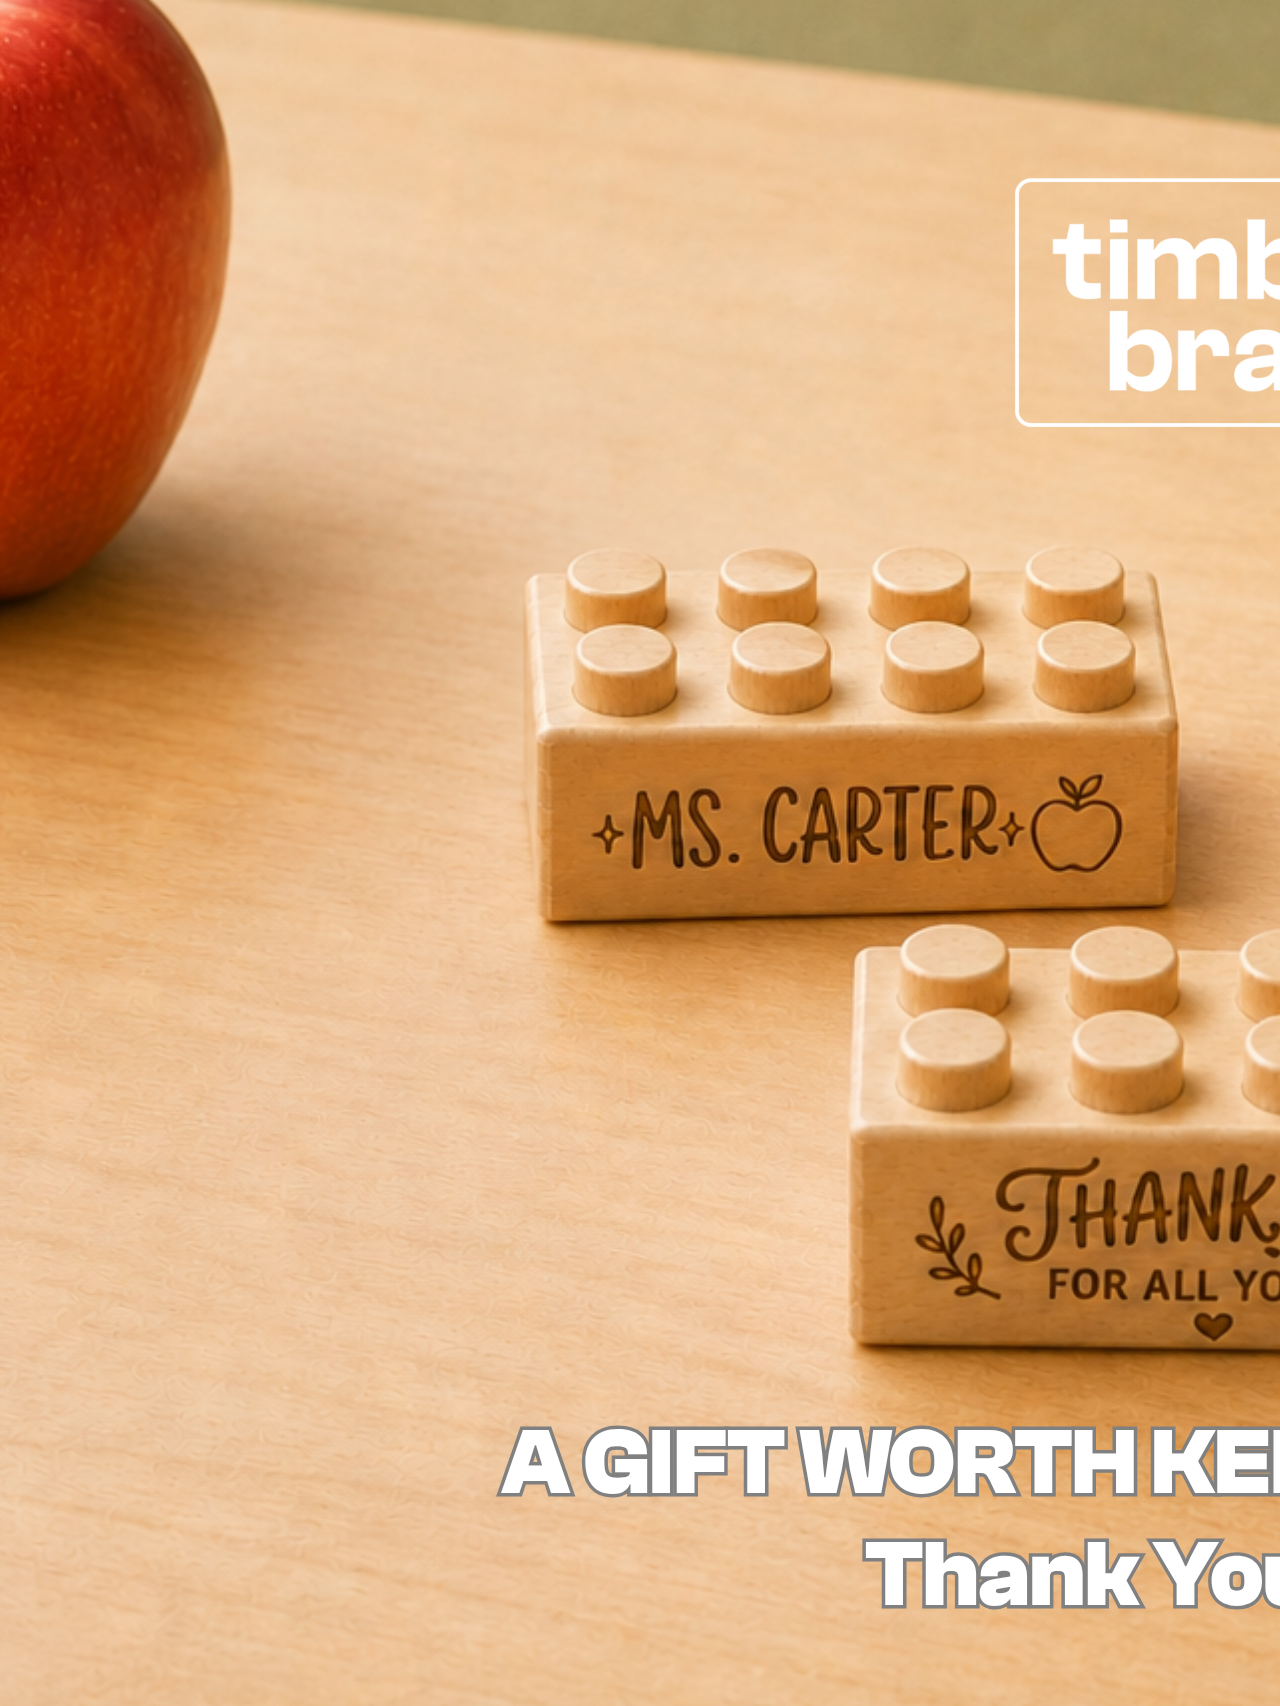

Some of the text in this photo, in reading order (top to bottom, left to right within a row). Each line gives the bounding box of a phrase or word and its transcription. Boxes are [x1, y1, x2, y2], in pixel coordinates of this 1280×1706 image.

[631, 784, 999, 870] MS. CARTER
[1048, 1267, 1129, 1301] FOR
[1143, 1269, 1219, 1302] ALL
